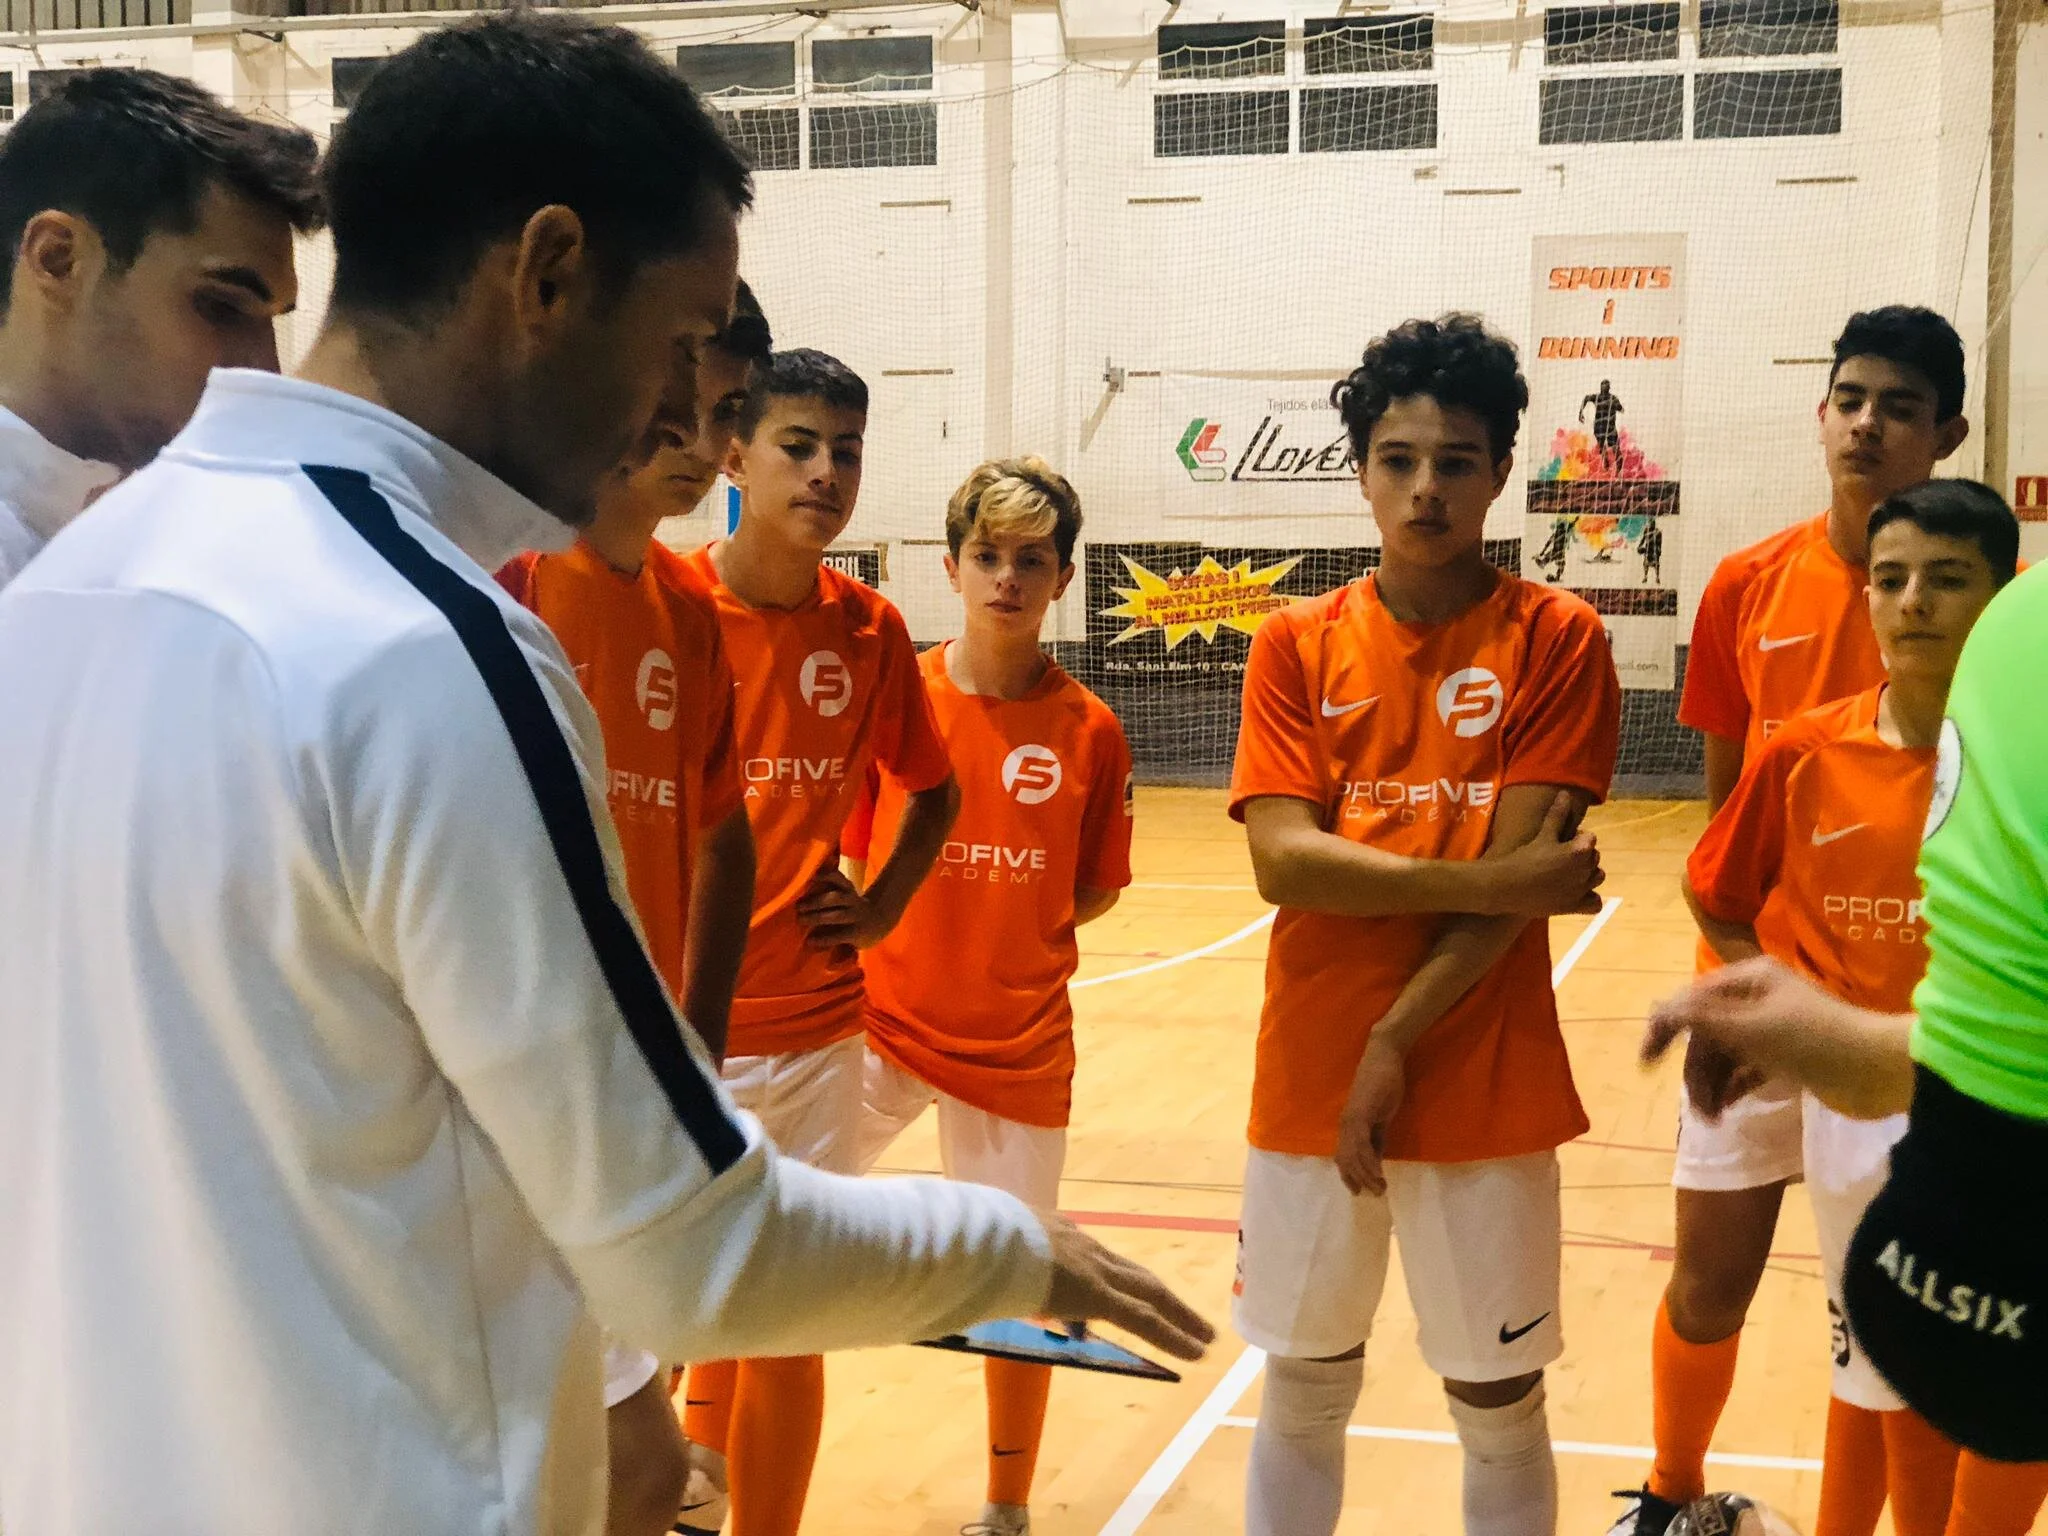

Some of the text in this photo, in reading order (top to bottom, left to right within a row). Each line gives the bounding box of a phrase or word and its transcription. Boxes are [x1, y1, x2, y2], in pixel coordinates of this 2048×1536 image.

[1548, 266, 1672, 290] SPORTS
[1538, 336, 1680, 360] RUNNING
[1268, 398, 1337, 414] Tejidos elás
[742, 757, 845, 782] OFIVE
[607, 768, 676, 807] FIVE
[942, 841, 1046, 869] OFIVE
[939, 866, 1031, 884] ADEM
[1847, 925, 1917, 944] CAD
[1876, 1239, 2028, 1340] ALLSIX
